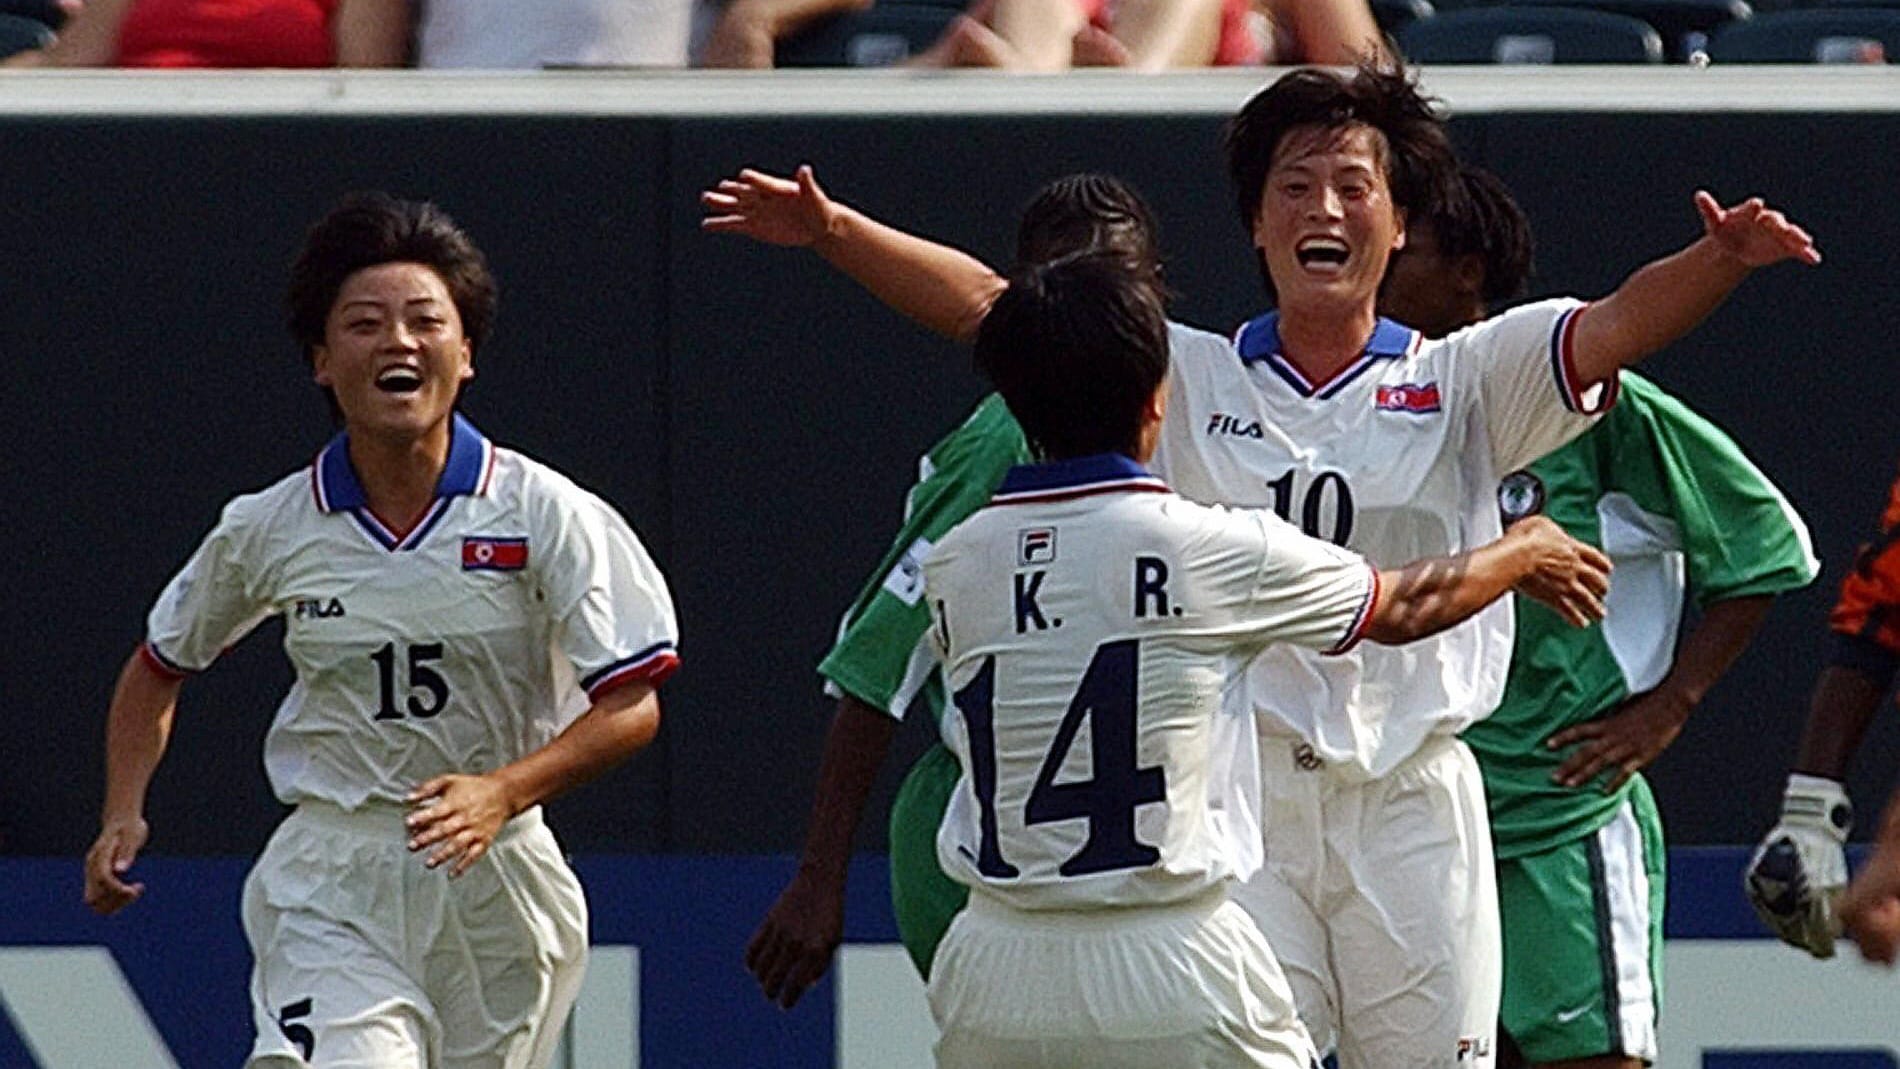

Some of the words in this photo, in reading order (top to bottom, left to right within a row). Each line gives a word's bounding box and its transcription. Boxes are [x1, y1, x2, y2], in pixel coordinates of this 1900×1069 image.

[1206, 414, 1264, 439] FILA
[1266, 468, 1354, 548] 10
[294, 596, 345, 619] FILA
[1013, 570, 1064, 634] K.
[1134, 556, 1183, 618] R.
[370, 641, 450, 721] 15
[952, 638, 1168, 878] 14
